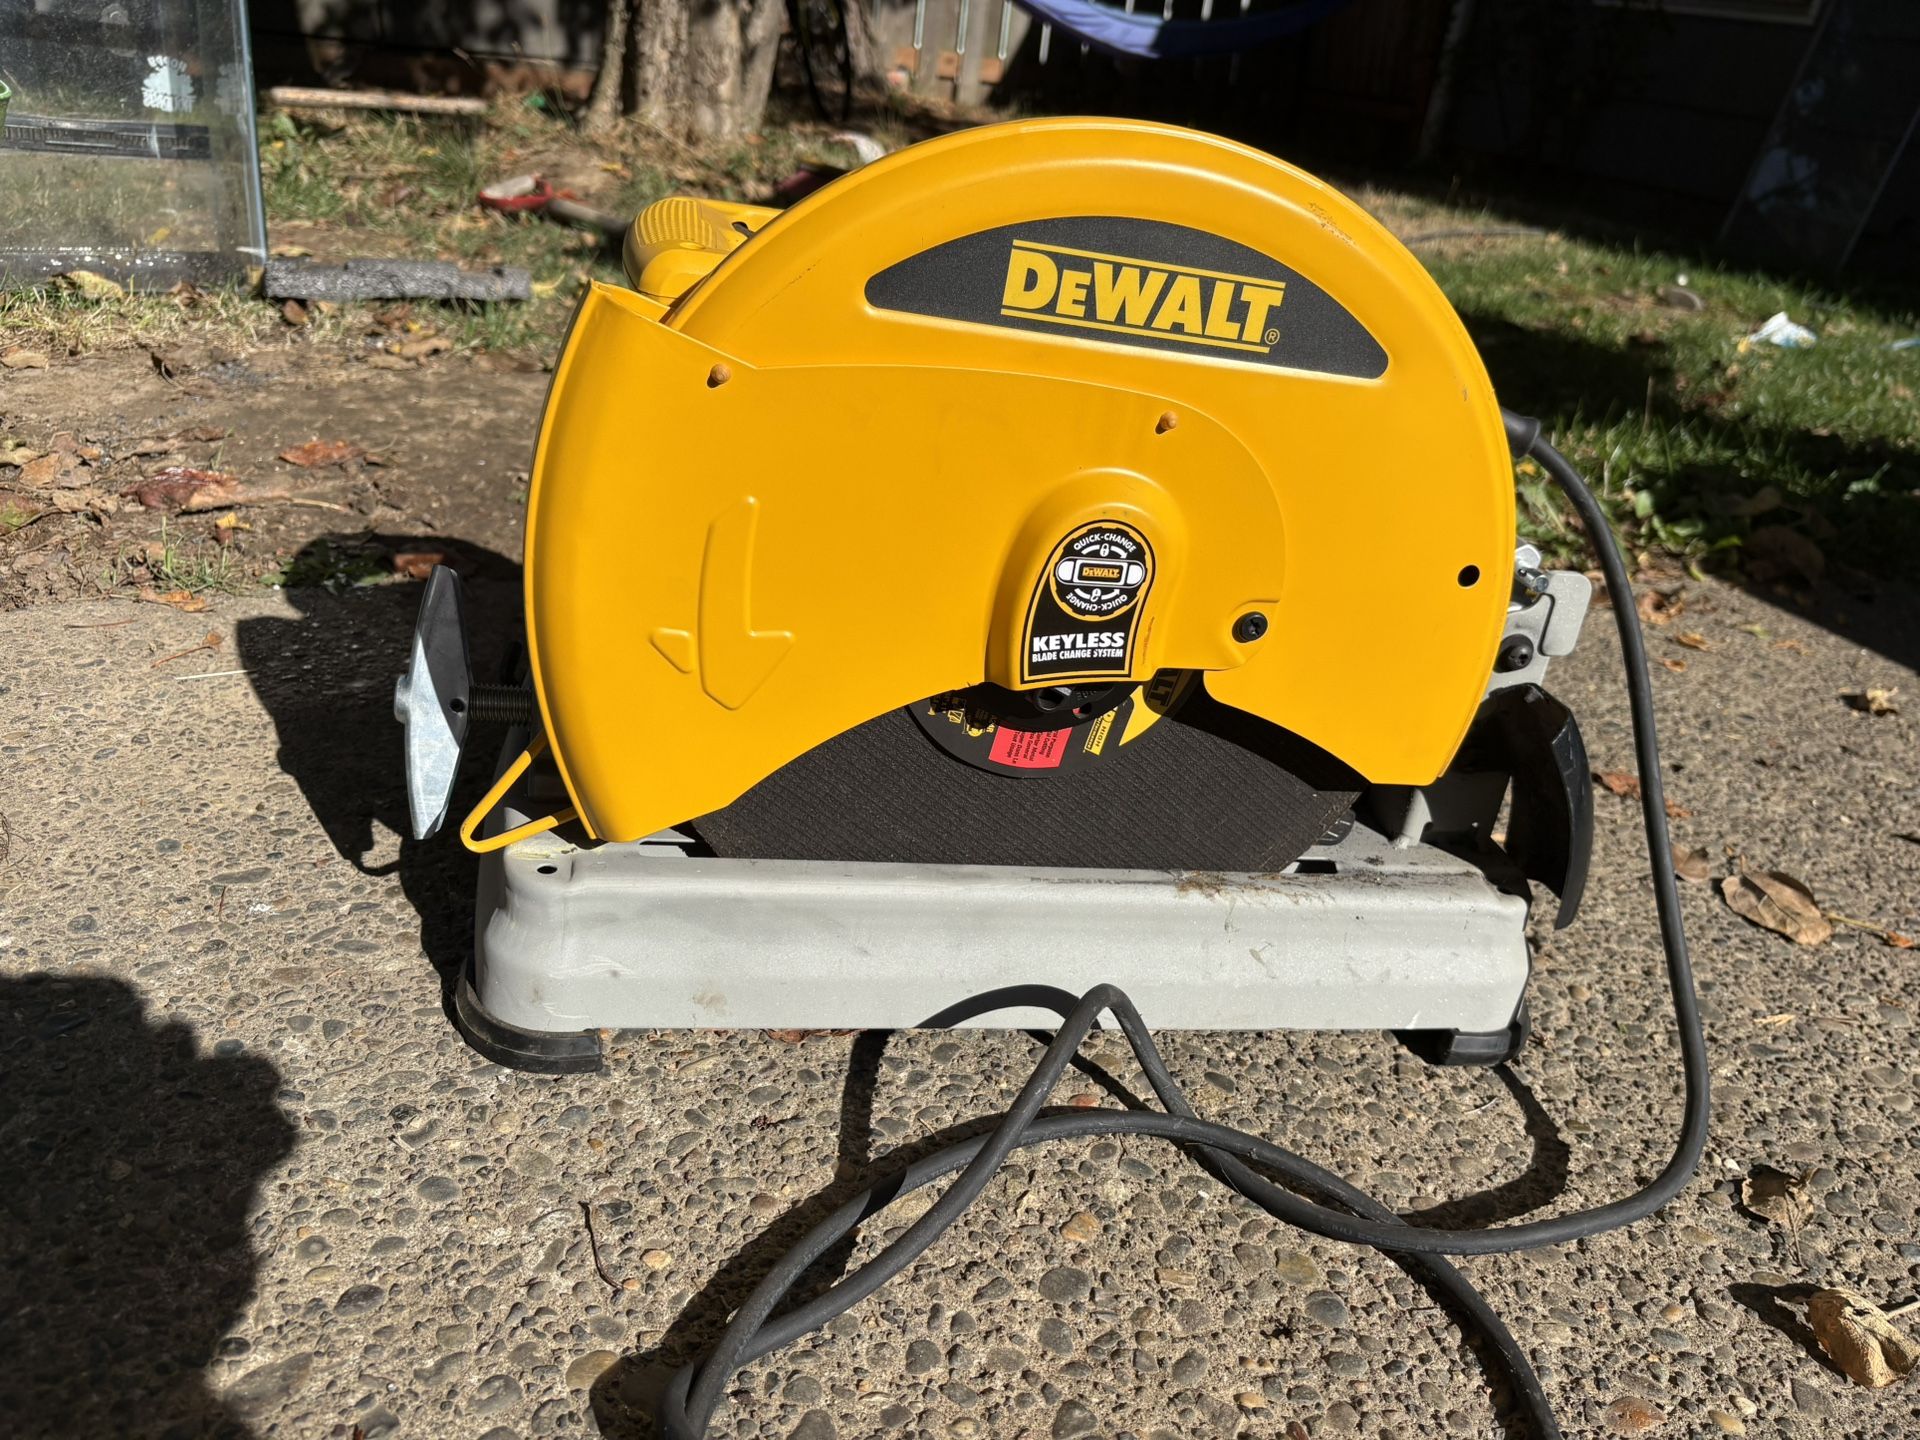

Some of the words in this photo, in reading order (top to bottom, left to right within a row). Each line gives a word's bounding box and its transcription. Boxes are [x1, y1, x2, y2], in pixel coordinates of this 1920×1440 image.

[1073, 533, 1137, 553] QUICK-CHANGE
[1066, 592, 1128, 611] QUICK-CHANGE
[1033, 632, 1125, 652] KEYLESS
[1032, 651, 1057, 662] BLADE
[1060, 649, 1091, 659] CHANGE
[1093, 648, 1123, 658] SYSTEM
